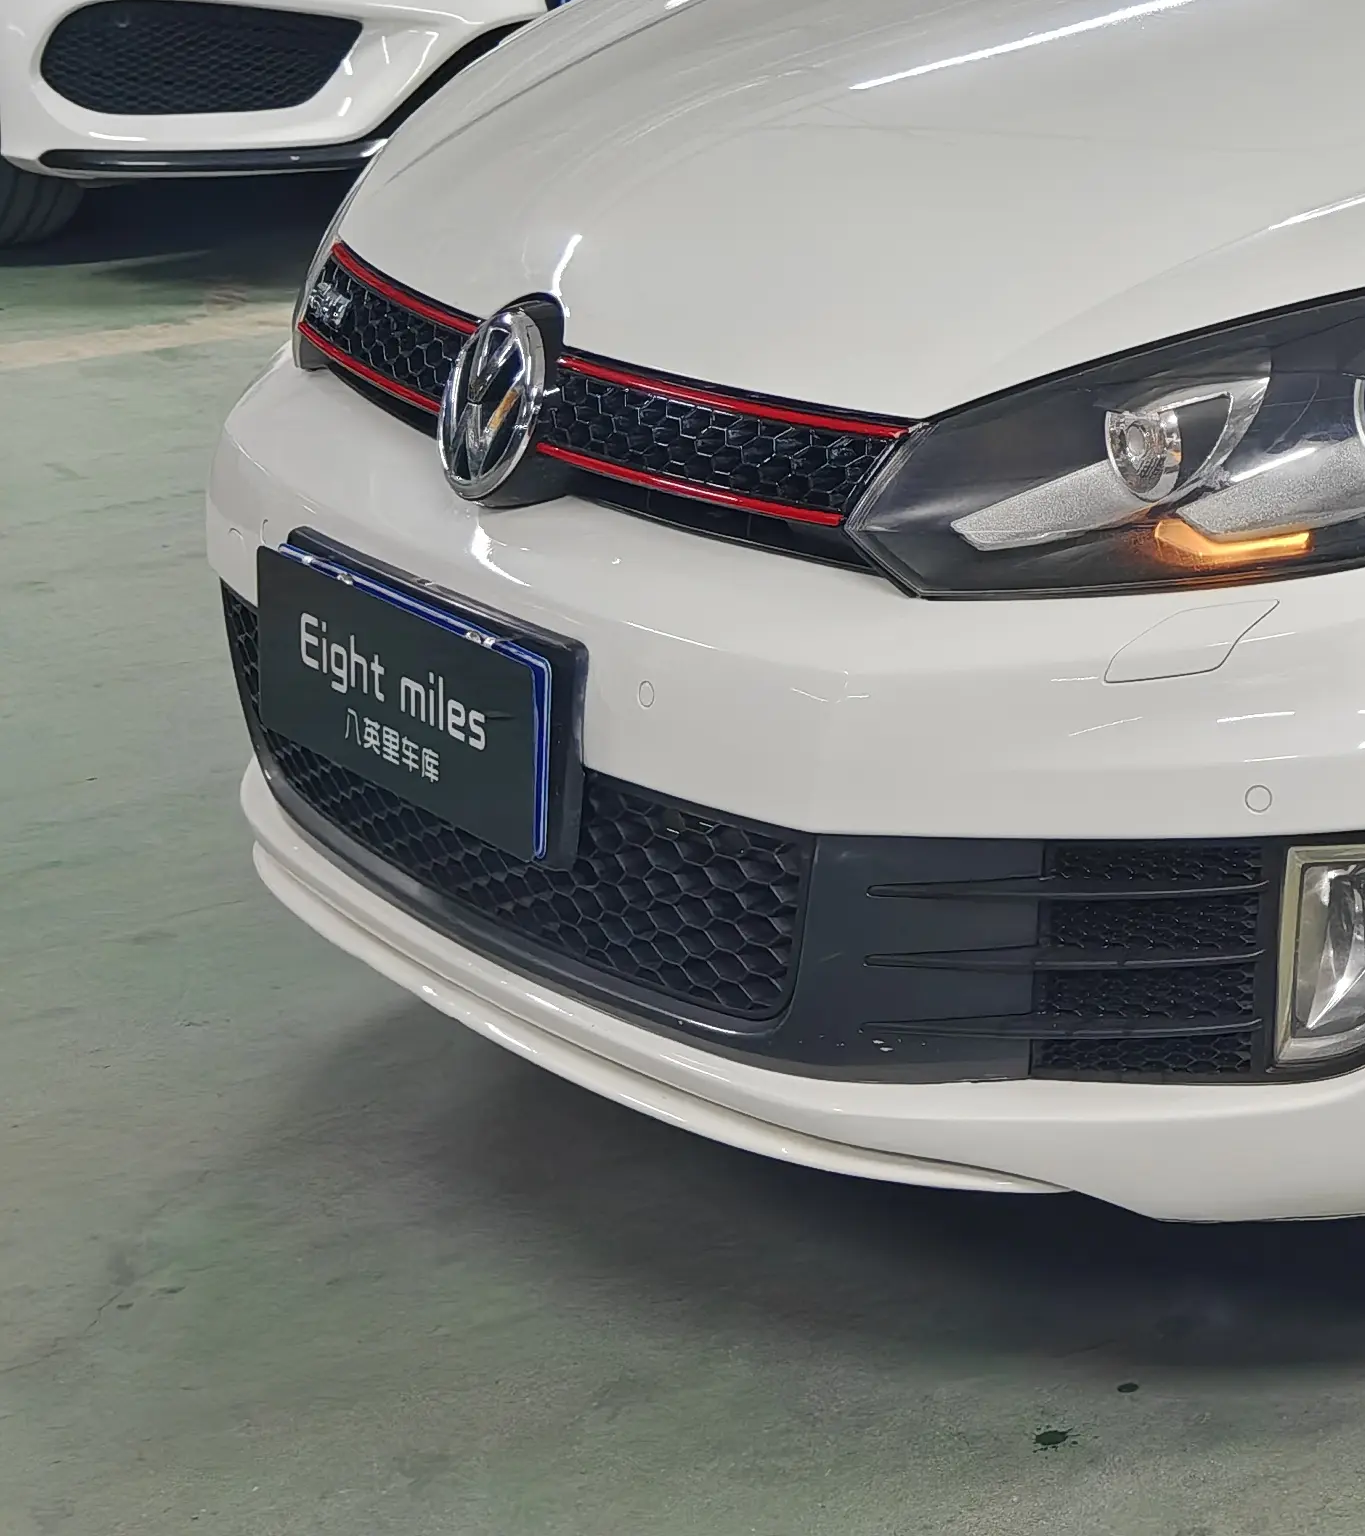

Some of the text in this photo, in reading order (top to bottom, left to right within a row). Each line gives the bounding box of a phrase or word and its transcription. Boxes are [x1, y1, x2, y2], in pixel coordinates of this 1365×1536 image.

[299, 611, 488, 752] Eight miles
[344, 707, 440, 783] 八英里车库
